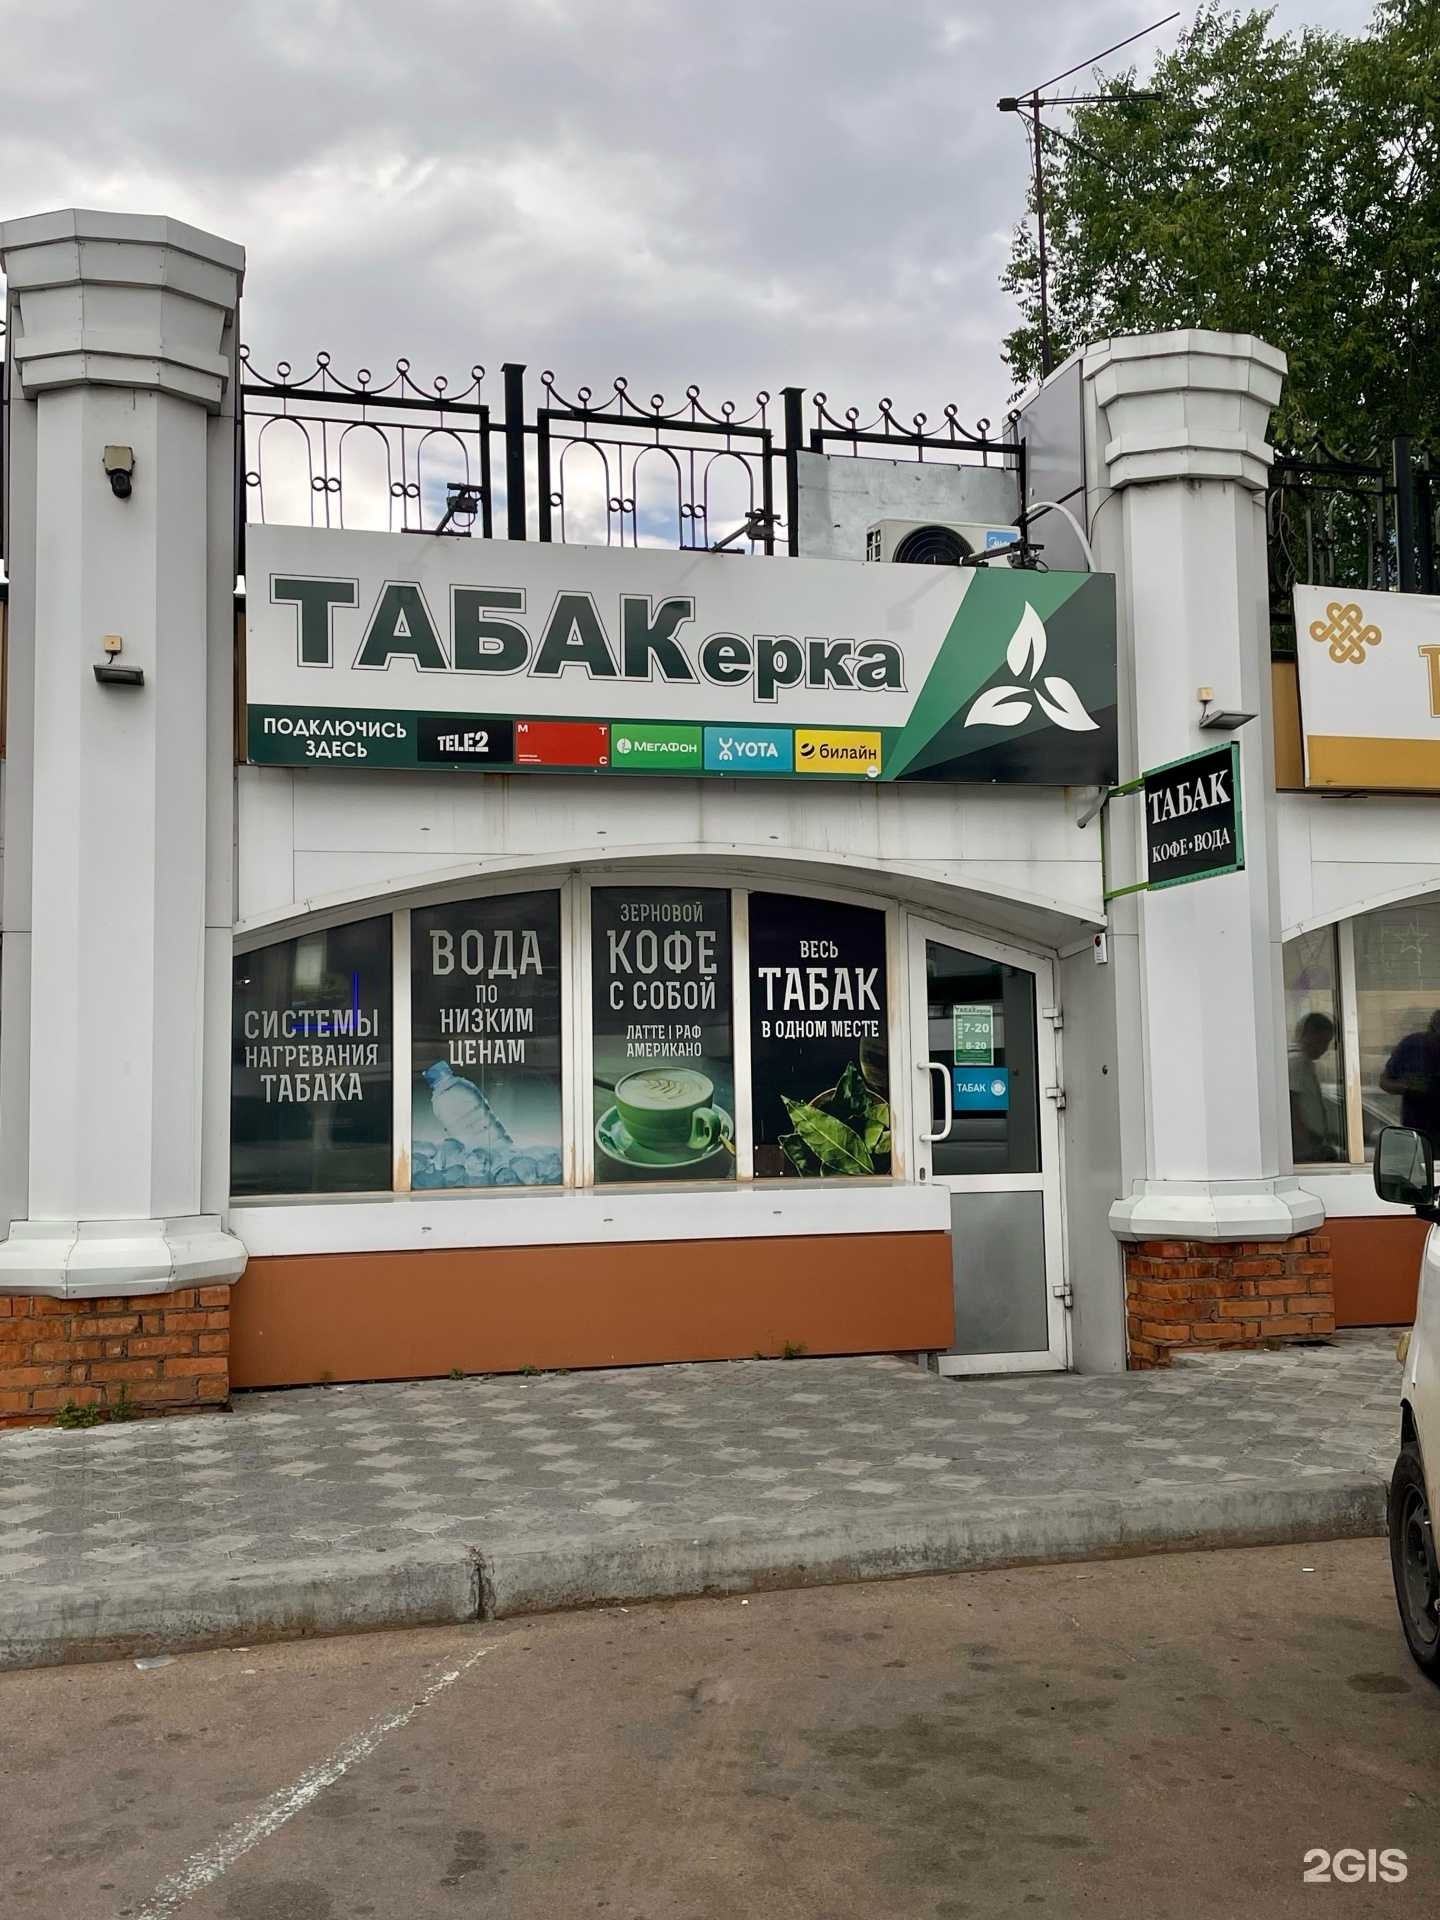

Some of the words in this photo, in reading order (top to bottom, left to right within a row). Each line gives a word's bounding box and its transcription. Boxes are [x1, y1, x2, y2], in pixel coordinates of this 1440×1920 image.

[269, 573, 908, 704] ТАБАКерка
[263, 717, 408, 739] ПОДКЛЮЧИСЬ
[304, 740, 368, 759] ЗДЕСЬ
[437, 731, 490, 753] TELE2
[735, 742, 778, 758] YOTA
[819, 743, 877, 760] билайн
[1149, 769, 1231, 824] ТАБАК
[620, 901, 703, 922] ЗЕРНОВОЙ
[429, 929, 543, 979] ВОДА
[606, 930, 717, 974] КОФЕ
[800, 940, 838, 958] ВЕСЬ
[475, 984, 498, 1003] ПО
[609, 981, 624, 1010] С
[632, 976, 716, 1010] СОБОЙ
[758, 967, 881, 1011] ТАБАК
[244, 1009, 378, 1039] СИСТЕМЫ
[440, 1008, 533, 1033] НИЗКИМ
[761, 1021, 771, 1037] В
[775, 1021, 828, 1039] ОДНОМ
[831, 1020, 880, 1038] МЕСТЕ
[964, 1023, 990, 1033] 7-20
[626, 1025, 665, 1040] ЛАТТЕ
[676, 1024, 702, 1040] РАФ
[245, 1044, 378, 1068] НАГРЕВАНИЯ
[449, 1039, 525, 1067] ЦЕНАМ
[626, 1042, 702, 1057] АМЕРИКАНО
[260, 1072, 363, 1103] ТАБАКА
[957, 1083, 986, 1092] ТАБАК
